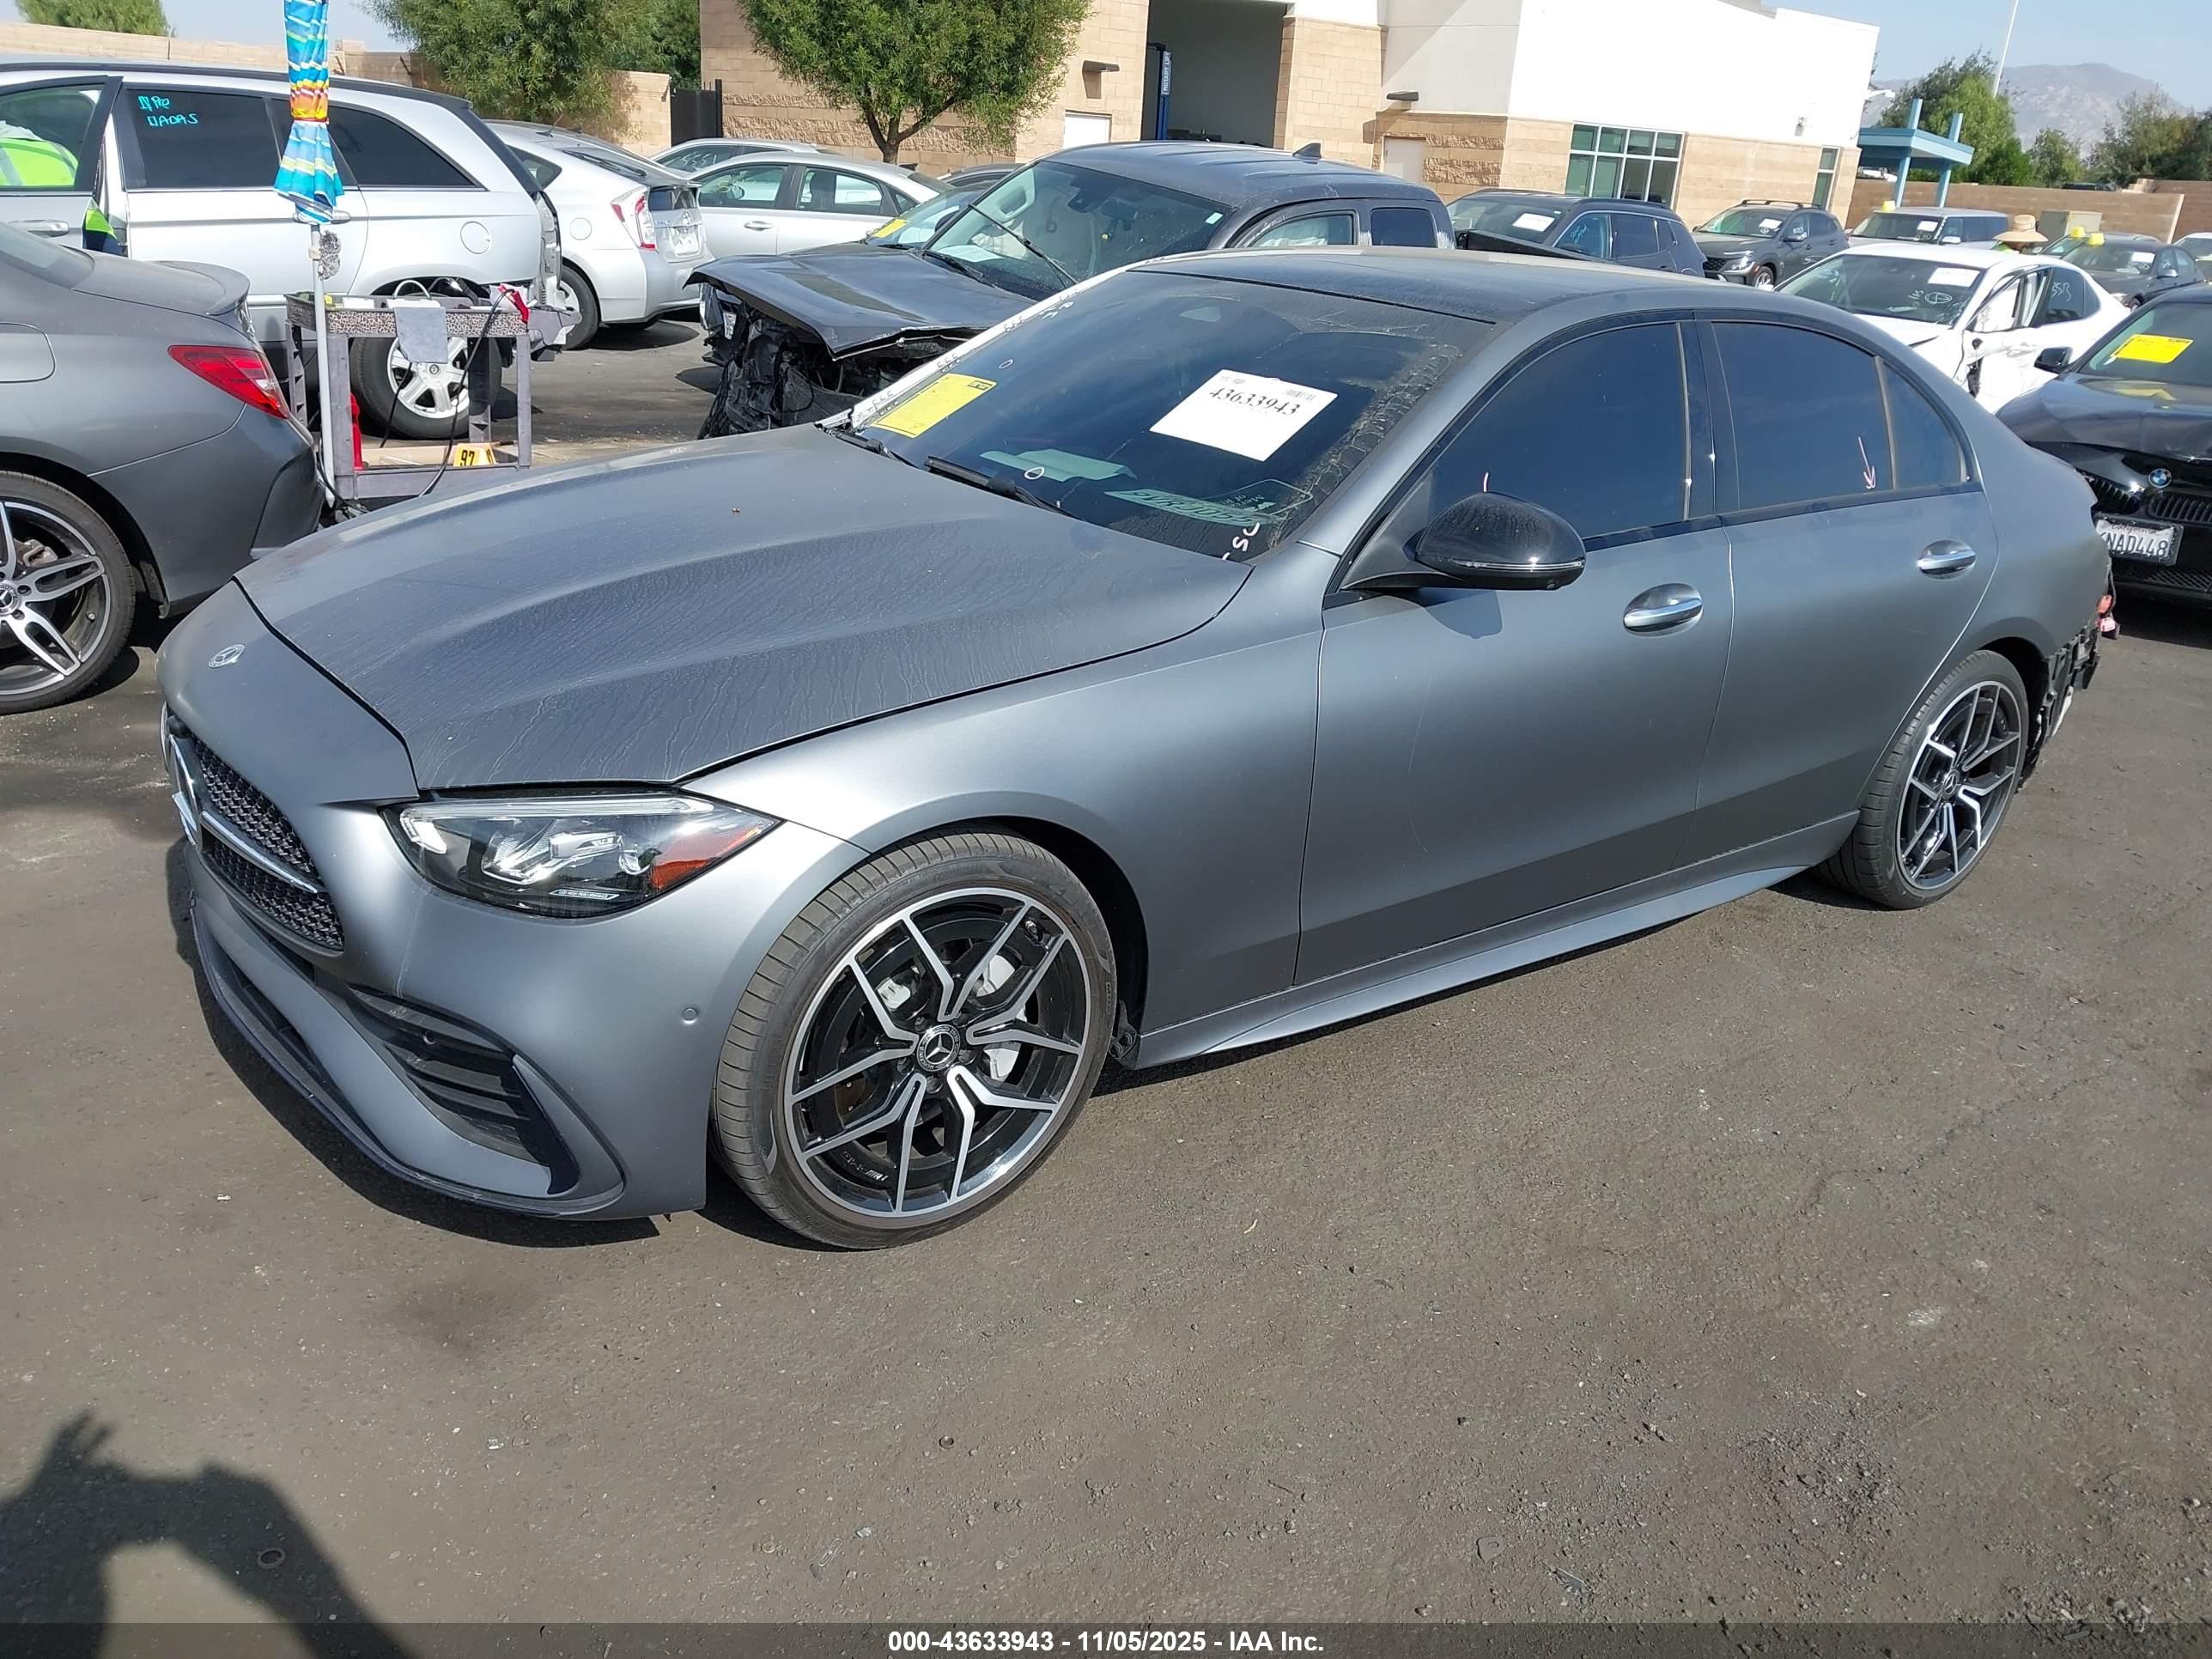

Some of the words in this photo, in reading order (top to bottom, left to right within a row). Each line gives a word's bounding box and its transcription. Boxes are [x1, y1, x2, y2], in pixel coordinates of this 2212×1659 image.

[1209, 387, 1300, 415] 43633943
[460, 449, 475, 466] 97
[2101, 532, 2168, 557] NAD448
